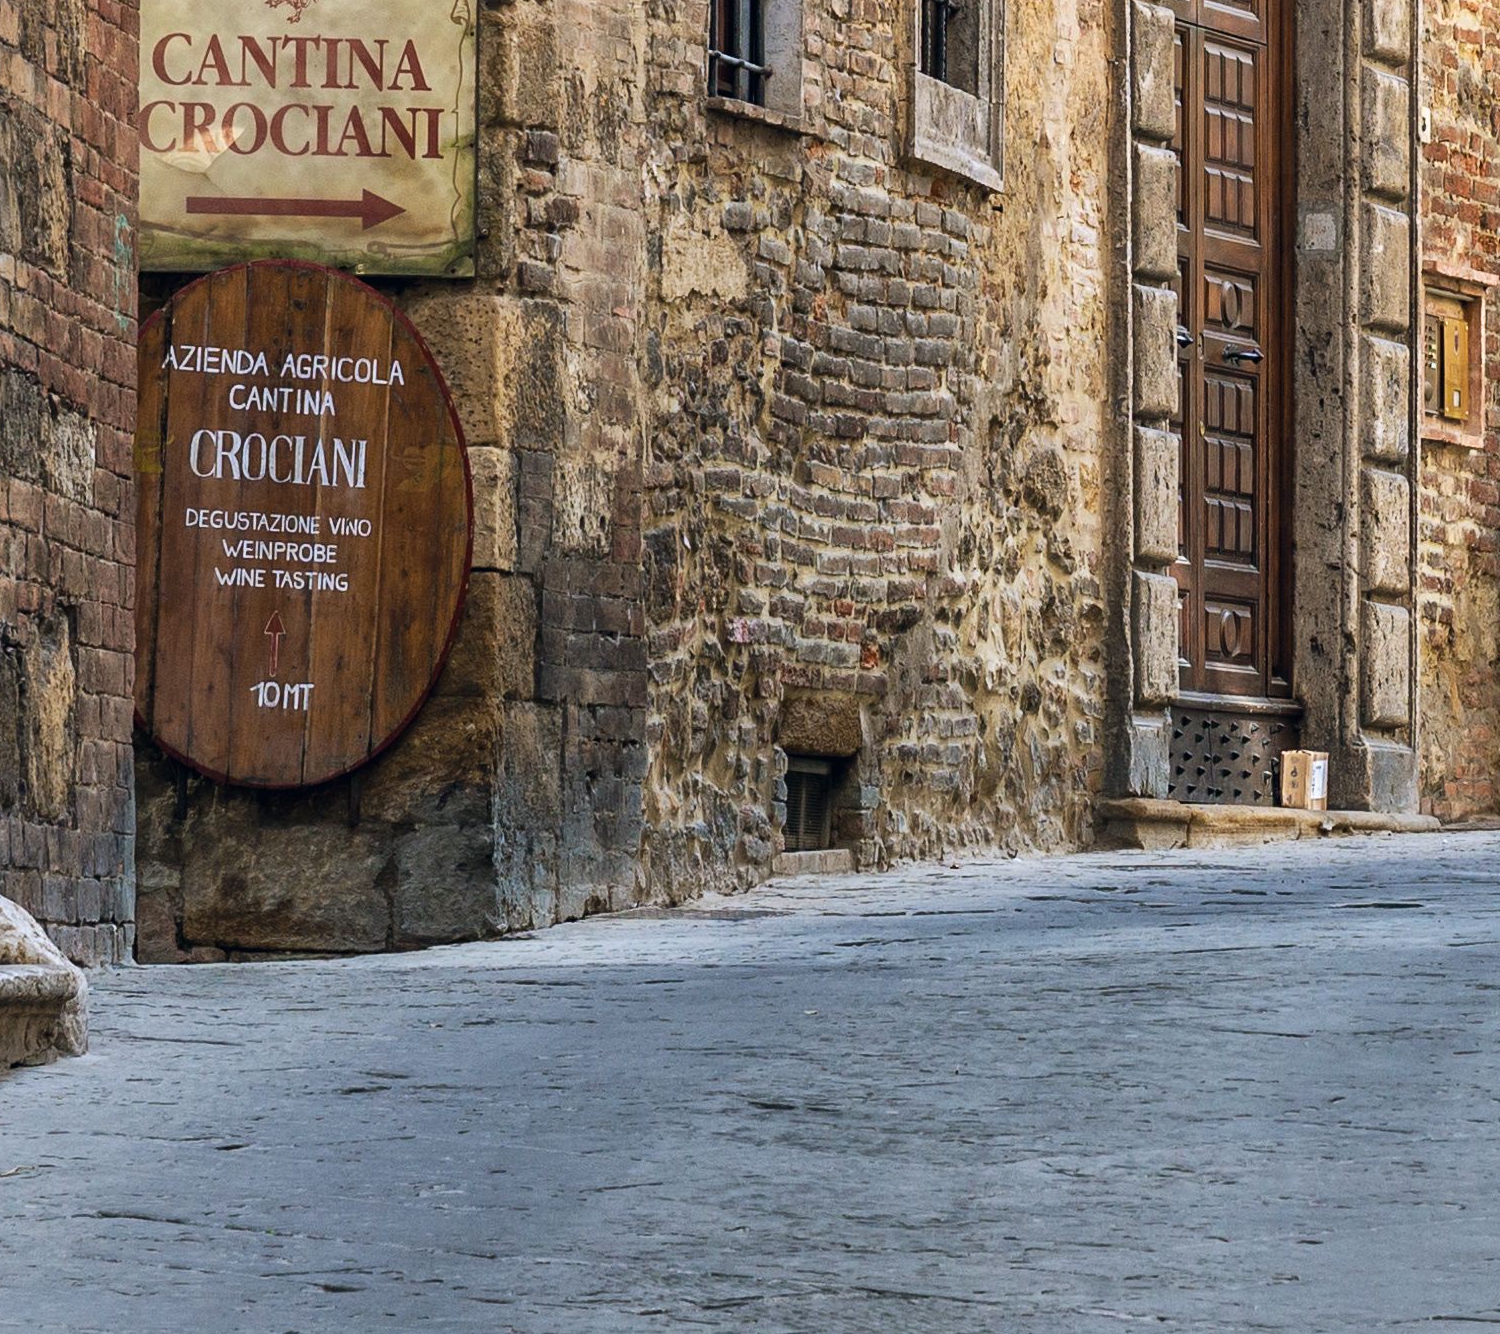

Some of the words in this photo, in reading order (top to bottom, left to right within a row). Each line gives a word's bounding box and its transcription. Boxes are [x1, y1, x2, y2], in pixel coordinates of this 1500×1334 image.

[152, 33, 432, 92] CANTINA
[139, 100, 445, 160] CROCIANI
[162, 345, 268, 376] AZIENDA
[280, 353, 404, 385] AGRICOLA
[229, 384, 335, 415] CANTINA
[190, 429, 367, 488] CROCIANI
[185, 508, 320, 534] DEGUSTAZIONE
[329, 517, 372, 537] VINO
[222, 539, 338, 563] WEINPROBE
[215, 567, 266, 588] WINE
[272, 570, 348, 592] TASTING
